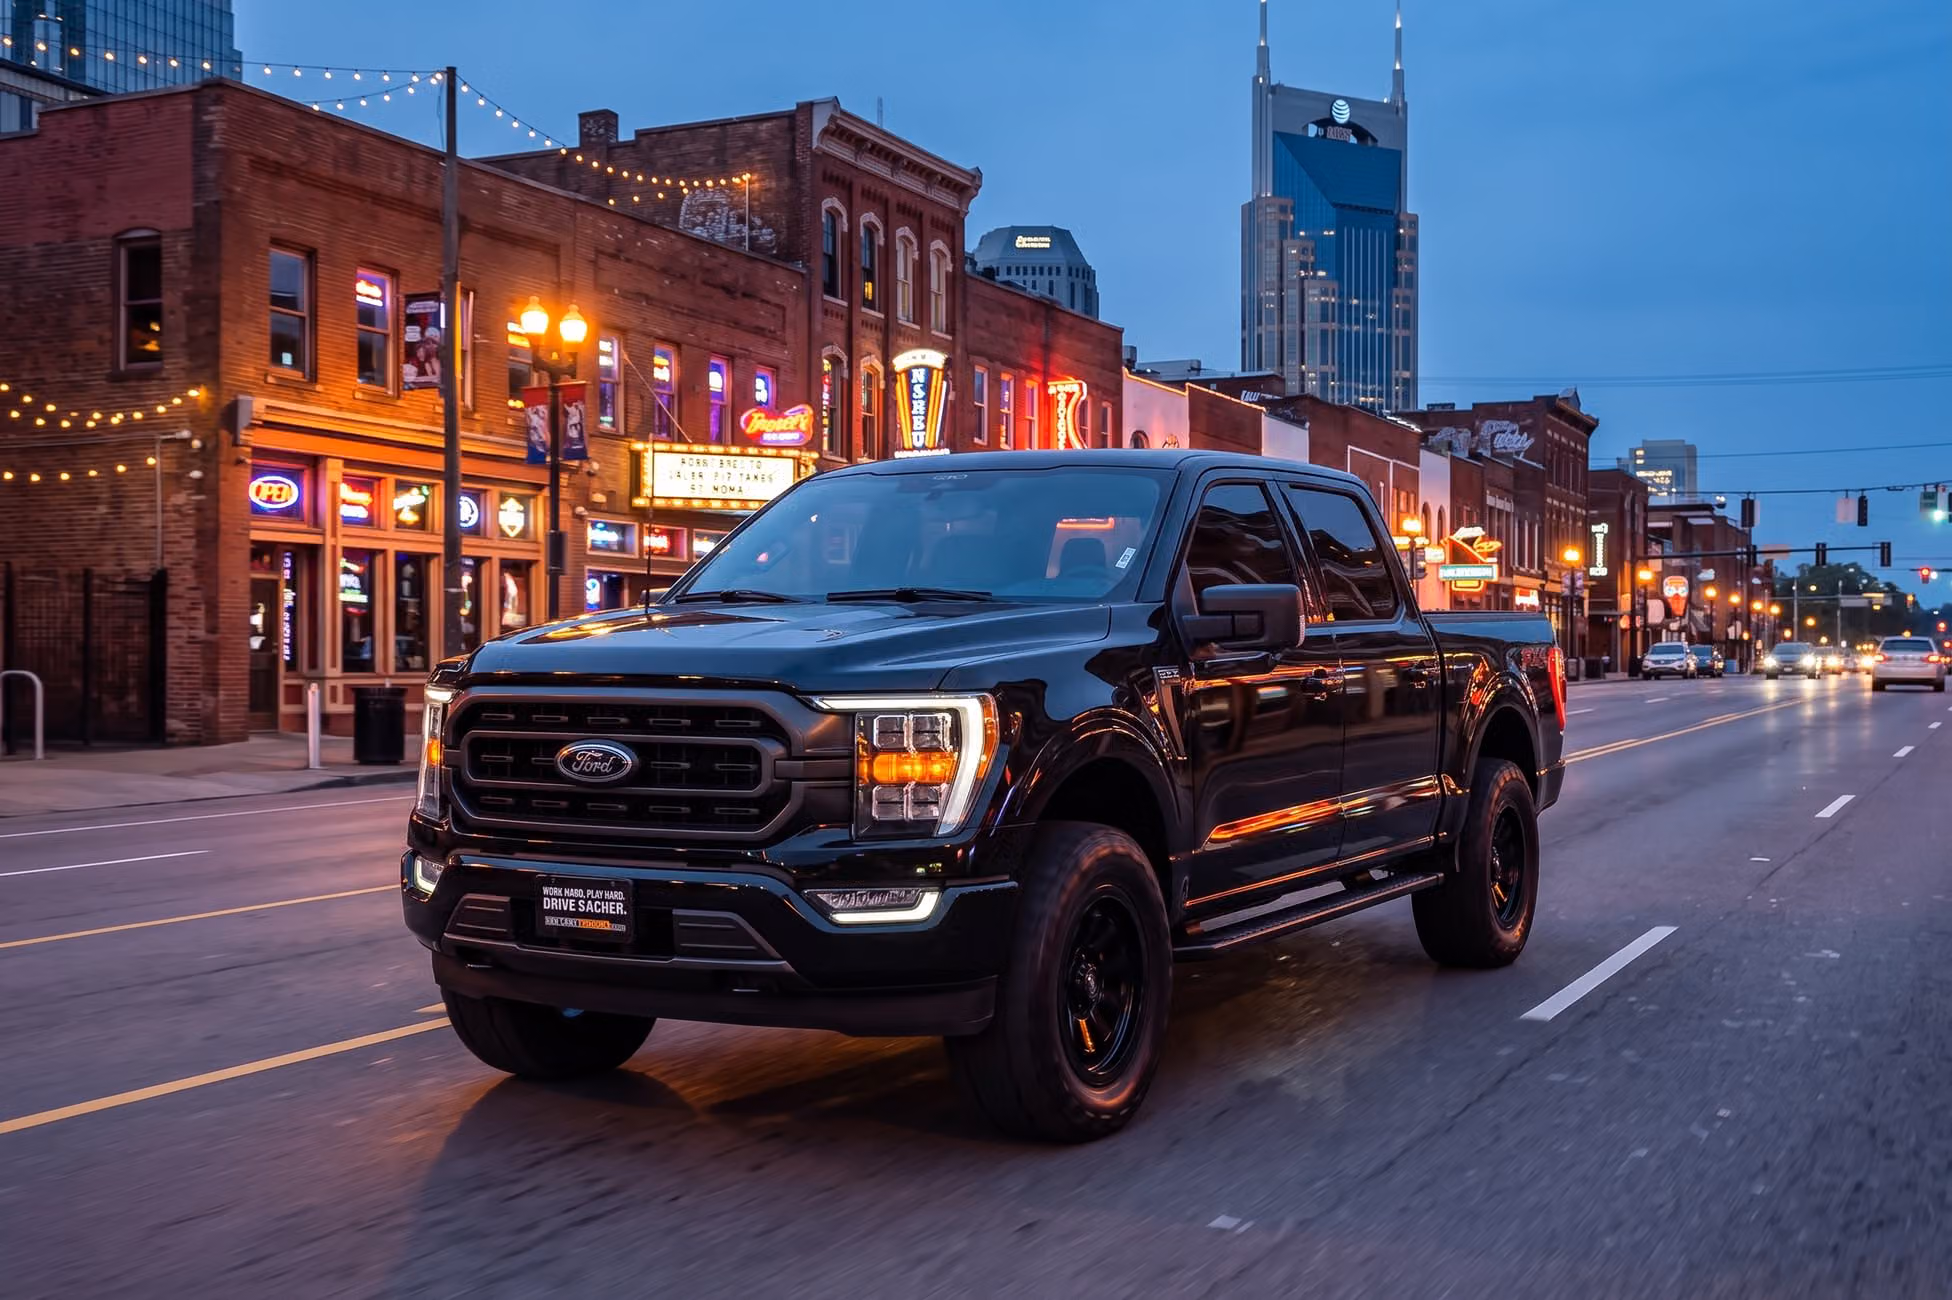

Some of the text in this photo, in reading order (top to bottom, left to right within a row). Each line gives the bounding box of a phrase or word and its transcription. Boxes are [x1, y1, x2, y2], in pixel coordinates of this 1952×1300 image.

[250, 482, 292, 503] OPEN
[572, 750, 617, 773] Ford
[542, 886, 563, 897] WORK
[586, 889, 604, 900] PLAY
[604, 890, 625, 901] HARD.
[543, 897, 627, 915] DRIVE SACHER.
